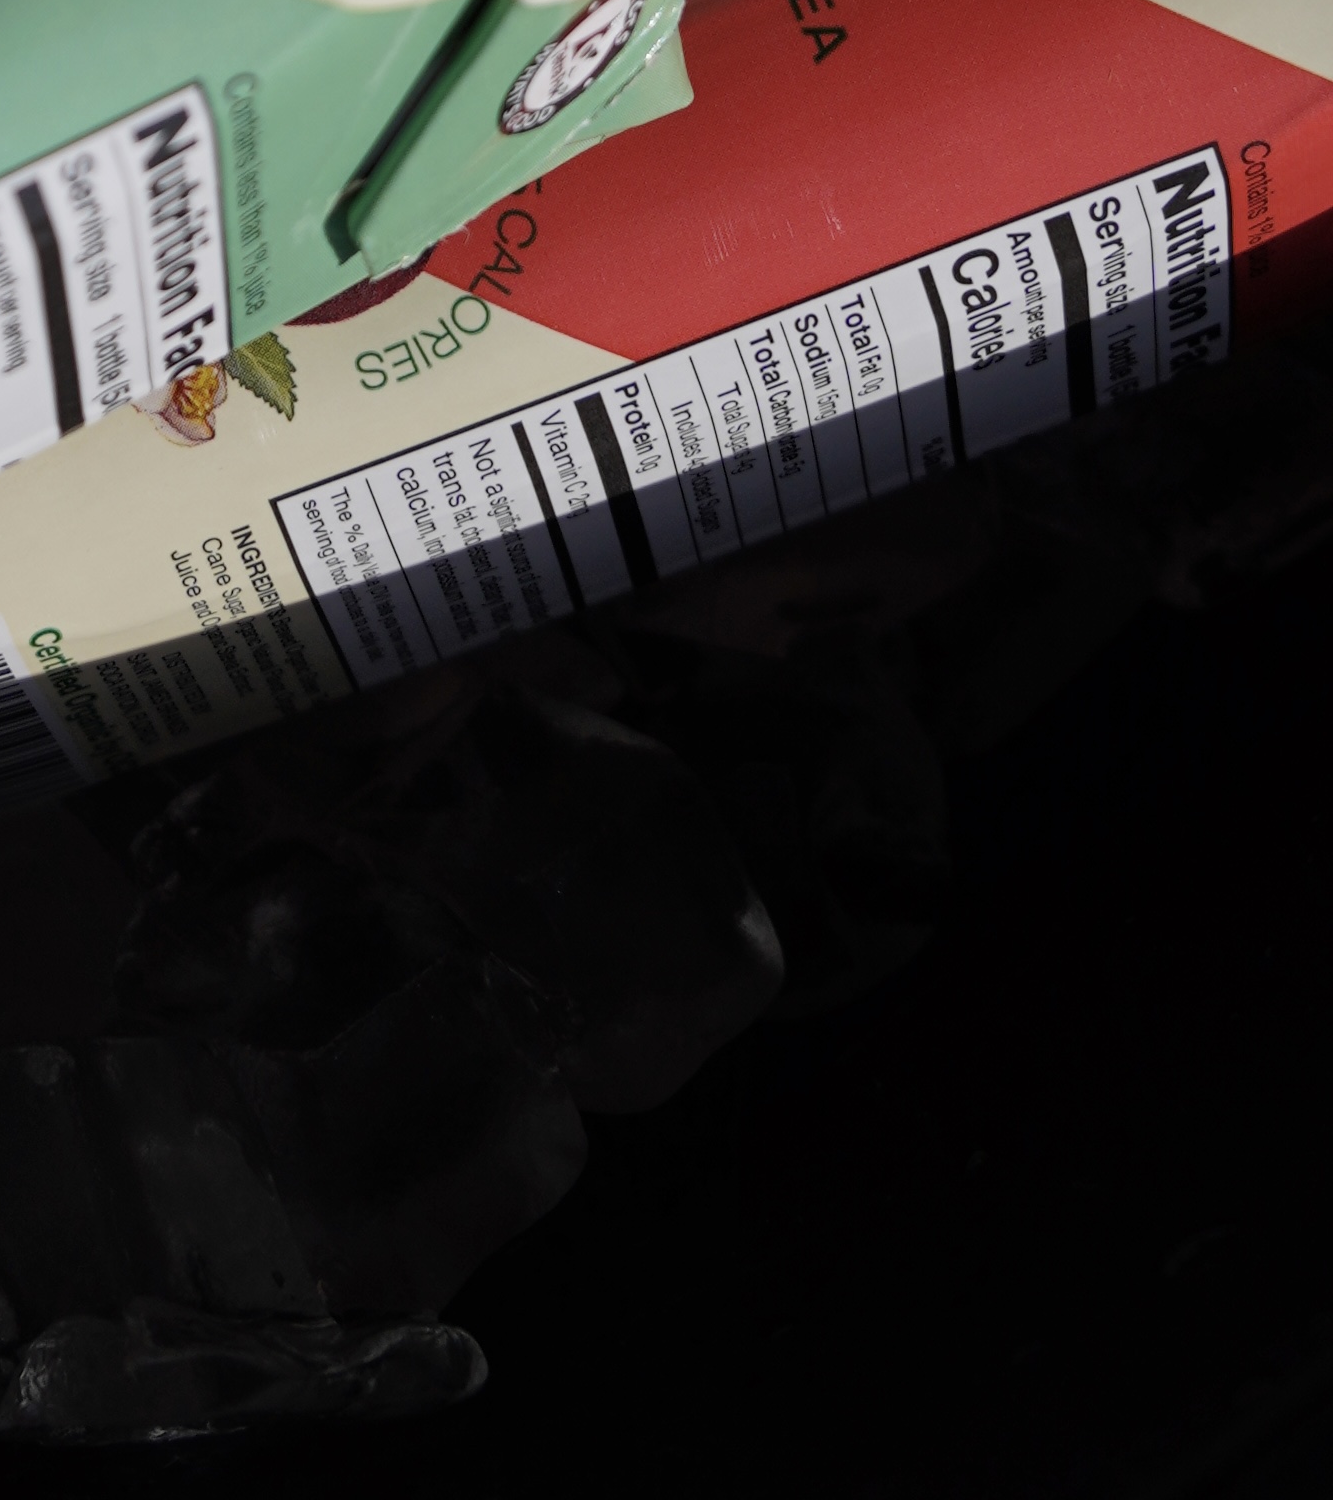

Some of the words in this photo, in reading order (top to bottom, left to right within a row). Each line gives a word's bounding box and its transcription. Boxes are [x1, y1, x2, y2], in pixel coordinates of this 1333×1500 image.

[60, 153, 112, 268] Serving
[133, 107, 210, 319] Nutrition
[1089, 196, 1133, 289] Serving
[1007, 231, 1046, 295] Amount
[1152, 161, 1221, 333] Nutrition
[355, 208, 539, 391] CALORIES
[841, 294, 880, 356] Total
[952, 248, 1013, 372] Calories
[749, 328, 789, 391] Total
[794, 313, 833, 391] Sodium
[540, 407, 580, 481] Vitamin
[614, 381, 657, 457] Protein
[433, 450, 467, 508] trans
[468, 437, 503, 481] Not
[302, 499, 335, 559] serving
[331, 485, 353, 522] The
[345, 523, 365, 544] %
[169, 549, 203, 598] Juice
[200, 535, 232, 589] Cane
